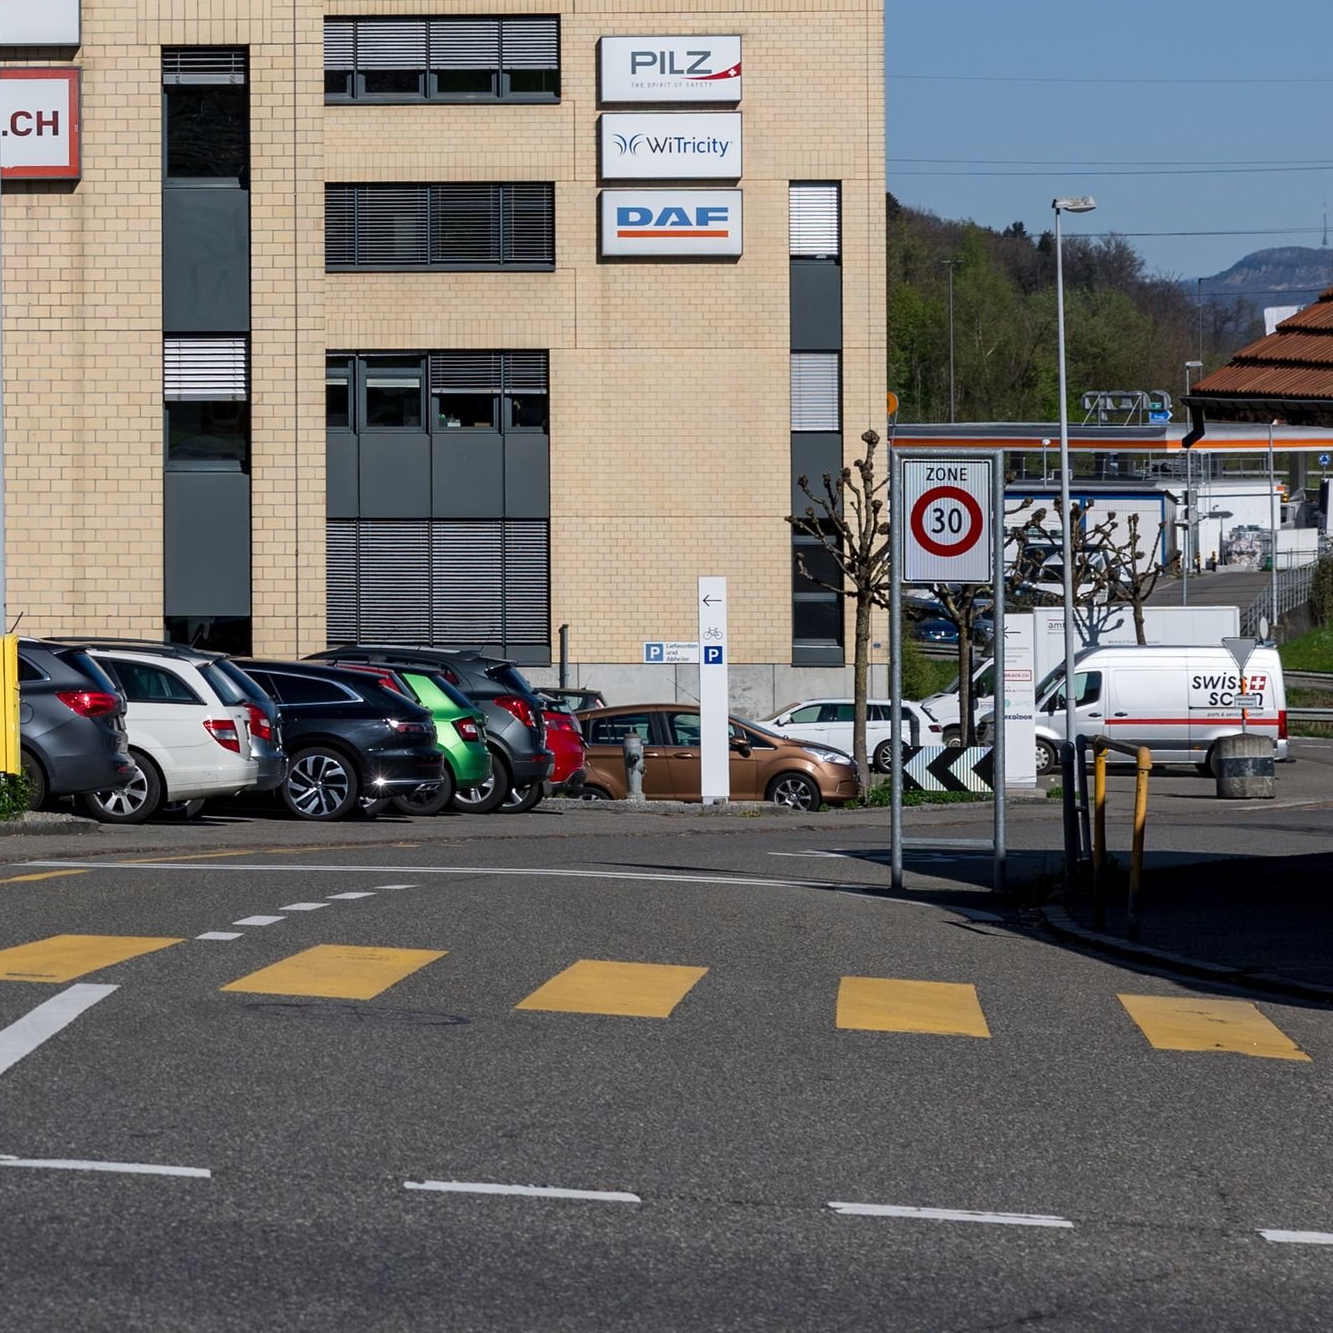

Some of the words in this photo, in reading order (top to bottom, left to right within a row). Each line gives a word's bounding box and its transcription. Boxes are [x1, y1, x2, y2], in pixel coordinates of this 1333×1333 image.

[630, 51, 713, 75] PILZ
[646, 137, 730, 157] WiTricity
[617, 207, 729, 227] DAF
[926, 468, 967, 481] ZONE
[932, 508, 962, 534] 30
[650, 647, 660, 659] P
[709, 649, 719, 662] P
[1192, 672, 1247, 690] swiss
[1209, 692, 1263, 706] scn
